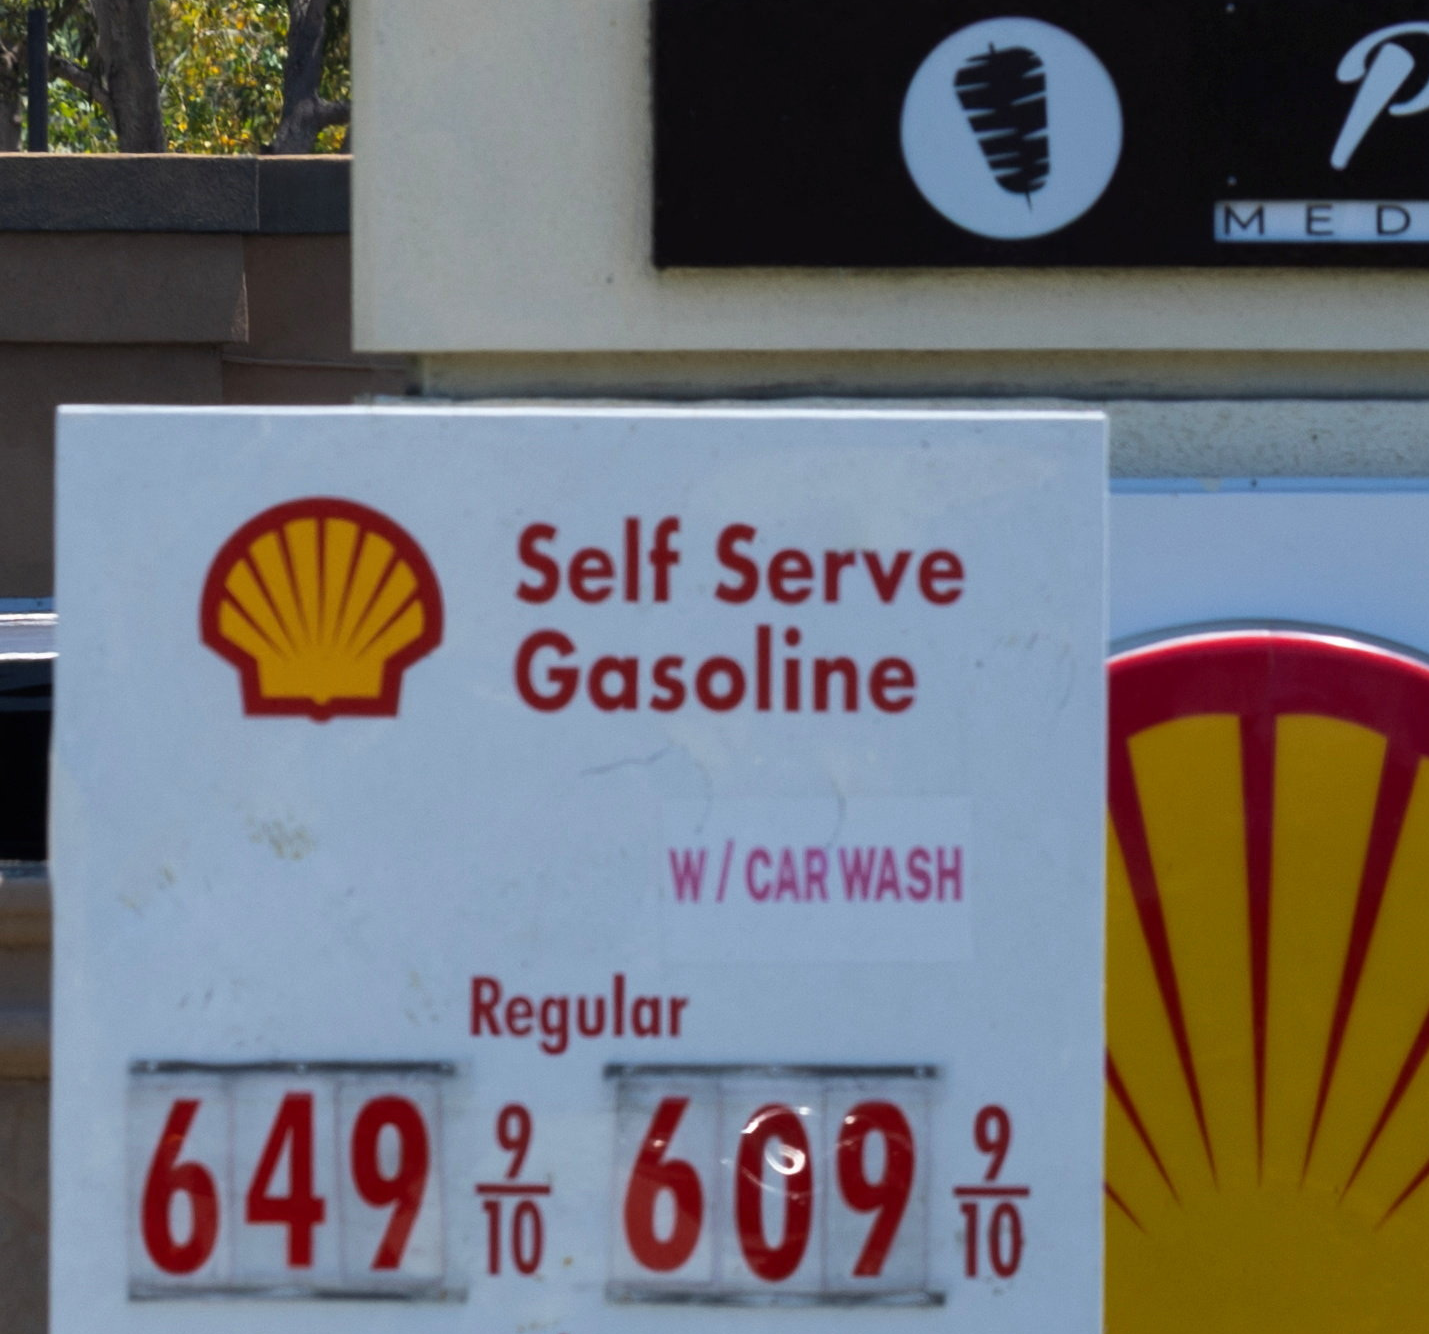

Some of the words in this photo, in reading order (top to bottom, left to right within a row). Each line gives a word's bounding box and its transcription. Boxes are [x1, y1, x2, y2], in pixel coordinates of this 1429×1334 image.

[515, 515, 682, 606] Self
[714, 522, 966, 607] Serve
[513, 623, 918, 715] Gasoline
[743, 843, 831, 904] CAR
[837, 843, 965, 904] WASH
[469, 972, 688, 1057] Regular
[138, 1089, 433, 1278] 649
[620, 1094, 918, 1285] 609
